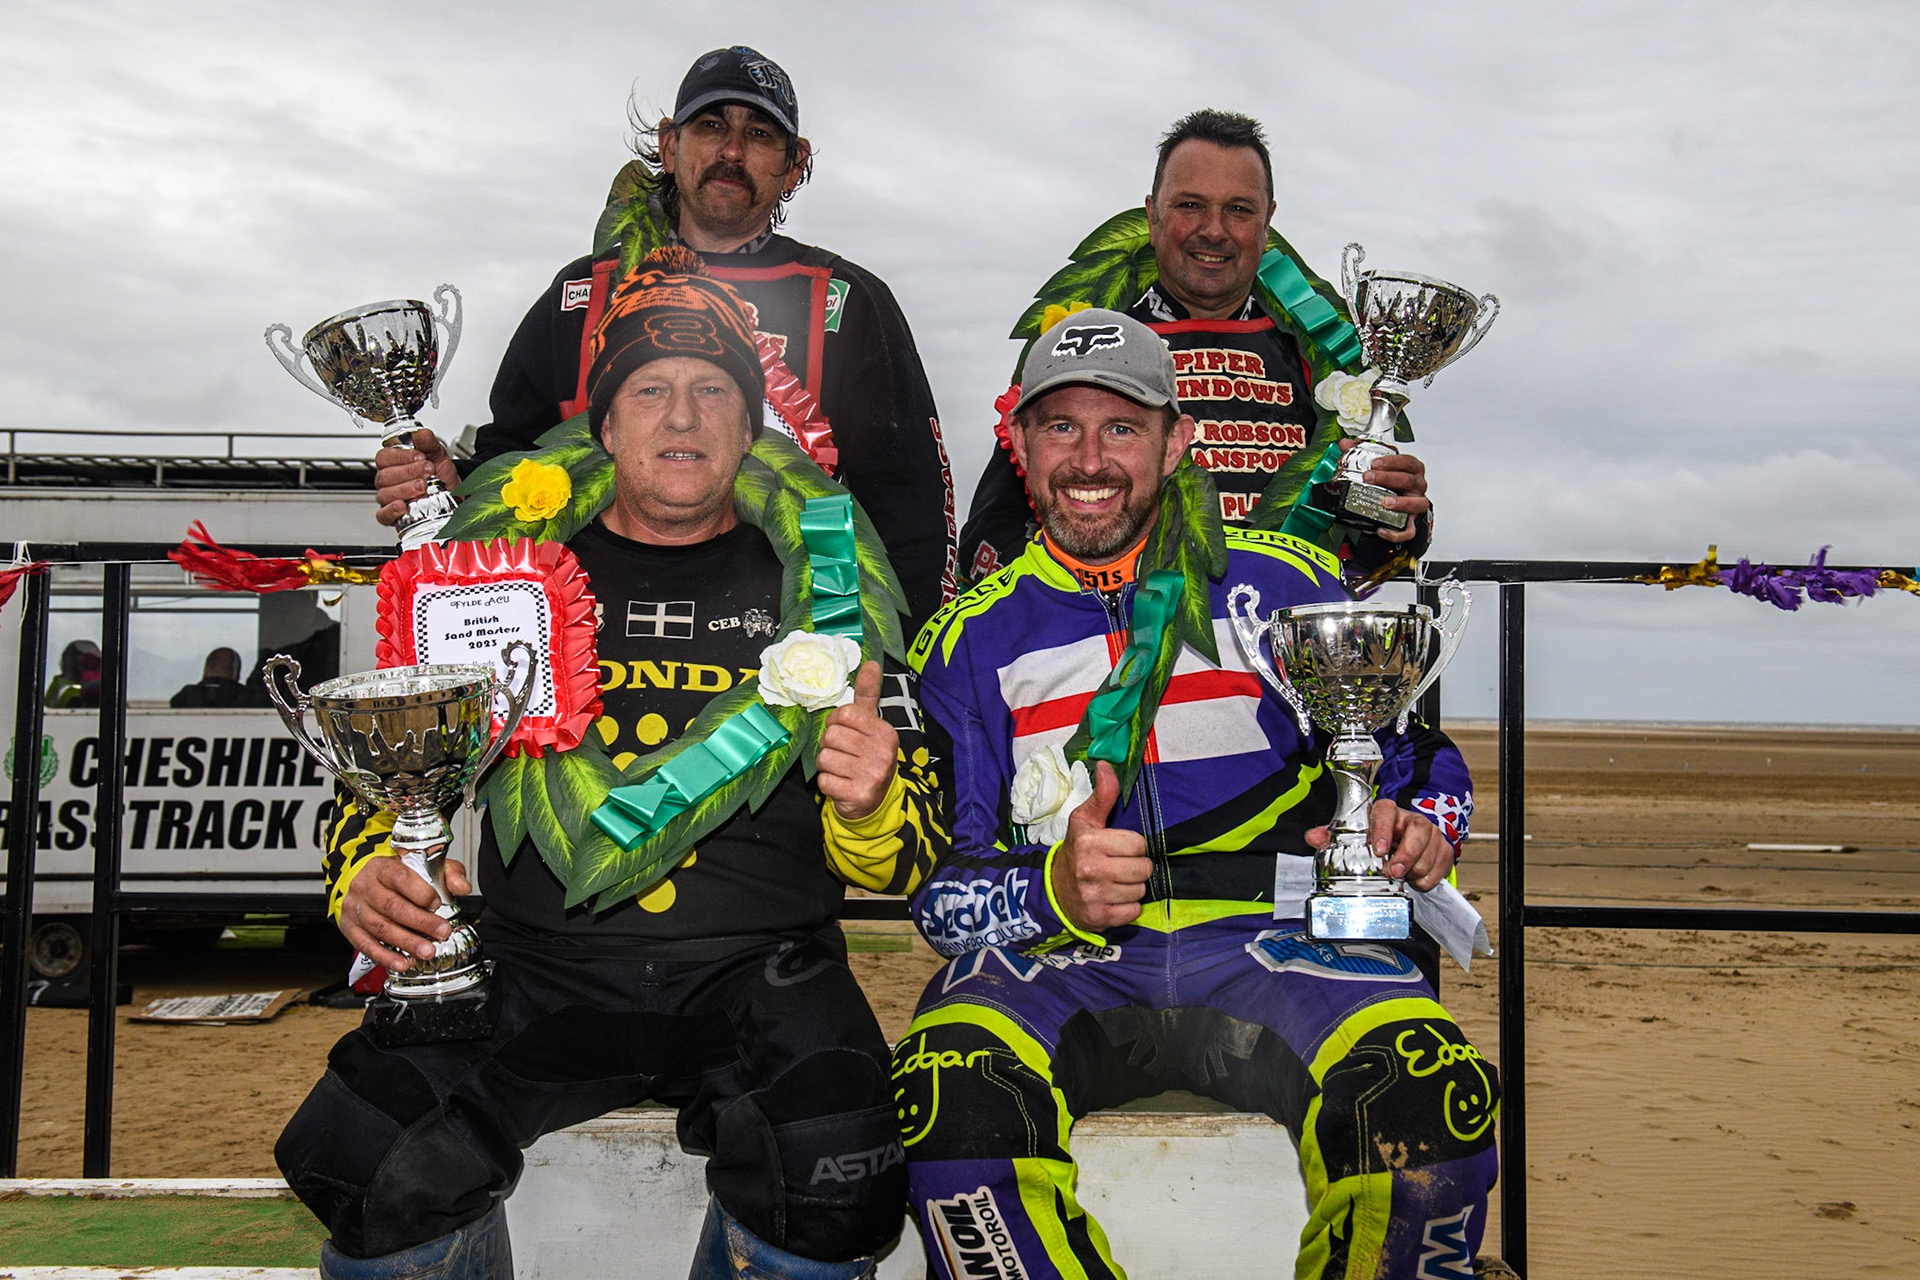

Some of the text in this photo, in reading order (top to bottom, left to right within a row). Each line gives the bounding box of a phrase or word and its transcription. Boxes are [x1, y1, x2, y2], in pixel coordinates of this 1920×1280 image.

[1172, 351, 1264, 376] PIPER
[1176, 378, 1292, 404] INDOWS
[1203, 423, 1304, 445] ROBSON
[463, 615, 500, 627] British
[707, 616, 742, 632] CEB
[914, 567, 1016, 657] GRACE
[444, 626, 521, 641] Sand Masters
[468, 639, 498, 650] 2023
[597, 659, 758, 693] OND
[68, 736, 327, 788] CHESHIRE
[939, 1198, 1002, 1280] NOIL
